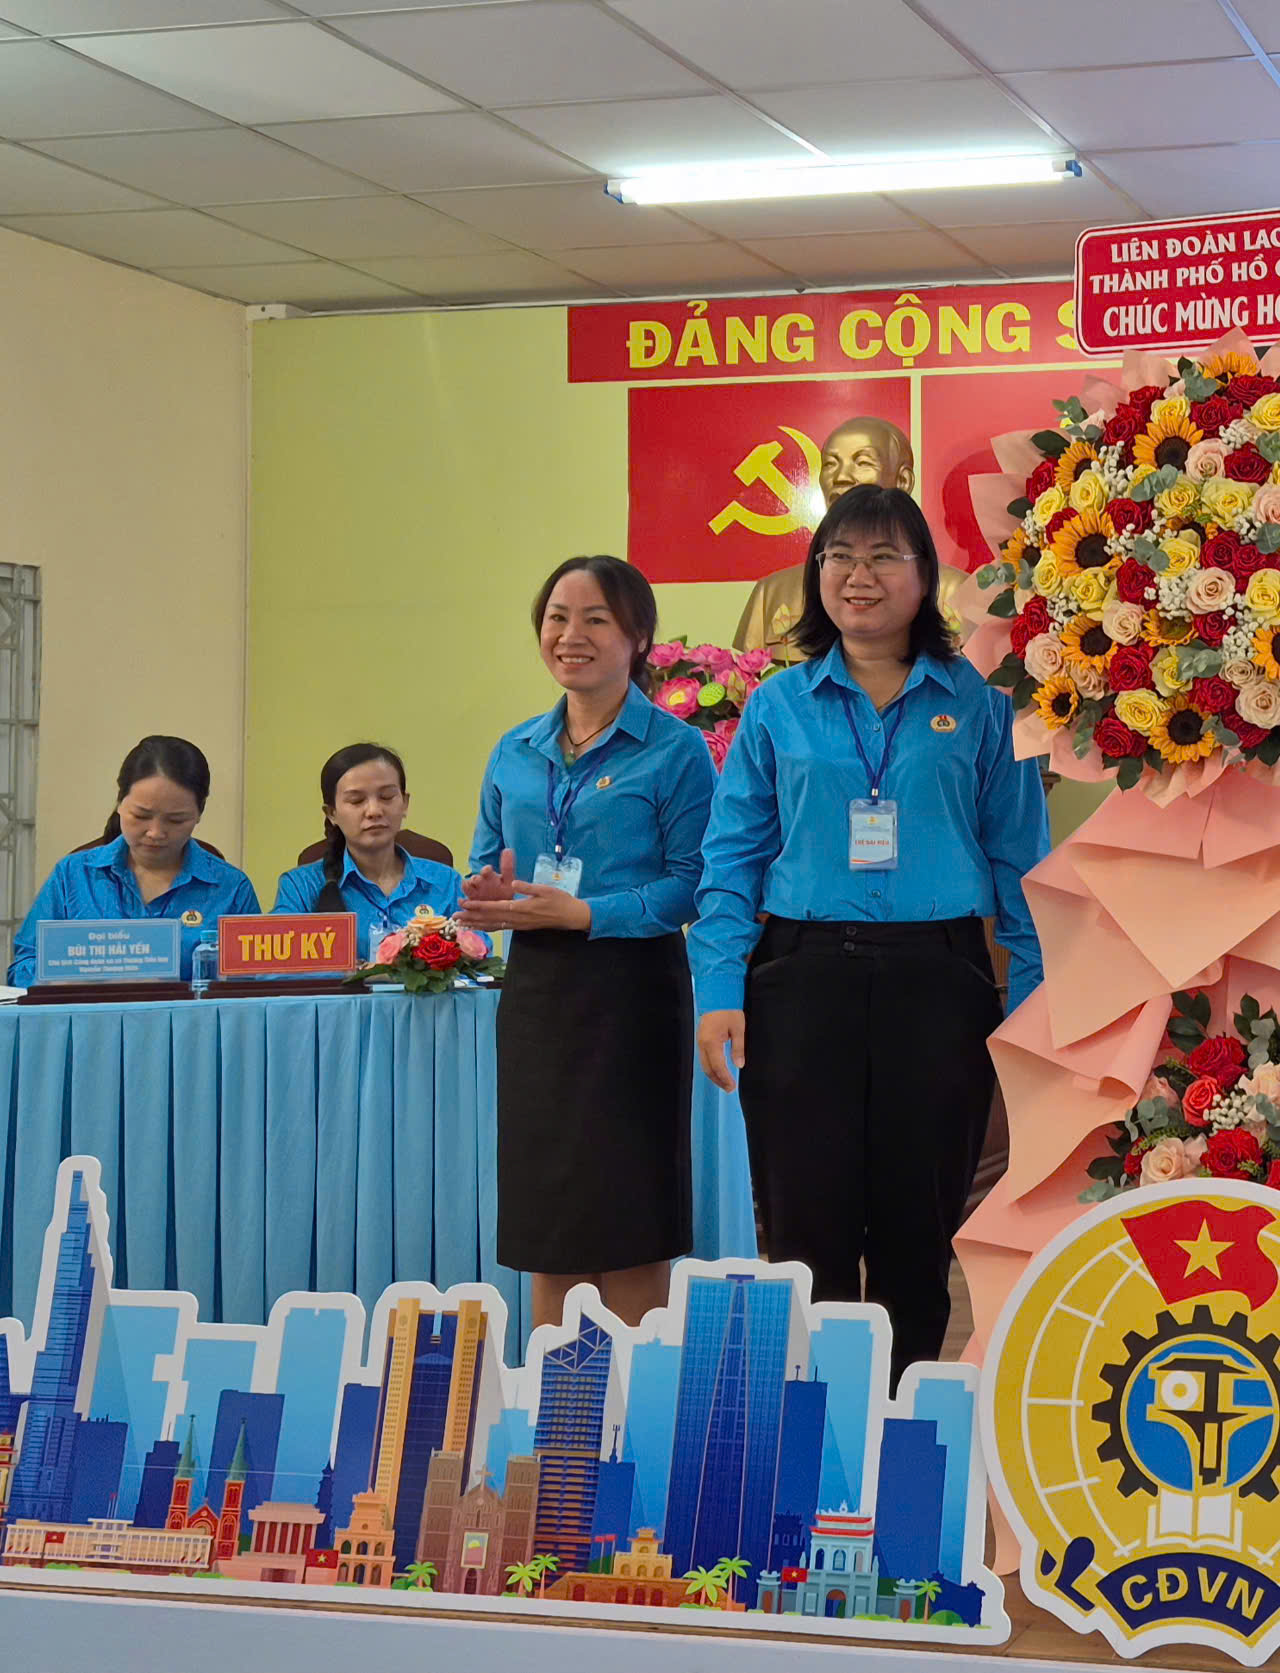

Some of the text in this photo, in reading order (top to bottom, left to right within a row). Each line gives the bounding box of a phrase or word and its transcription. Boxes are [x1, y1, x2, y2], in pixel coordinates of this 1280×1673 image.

[1111, 239, 1159, 263] LIÊN
[1166, 231, 1236, 258] ĐOÀN
[1090, 266, 1169, 294] THÀNH
[1176, 257, 1224, 288] PHỐ
[1231, 253, 1268, 282] HỒ
[626, 300, 815, 369] ĐẢNG
[839, 293, 1031, 367] CỘNG
[1103, 298, 1168, 337] CHÚC
[1175, 292, 1249, 332] MỪNG
[238, 926, 336, 961] THƯ KÝ
[1121, 1566, 1265, 1621] CĐVN
